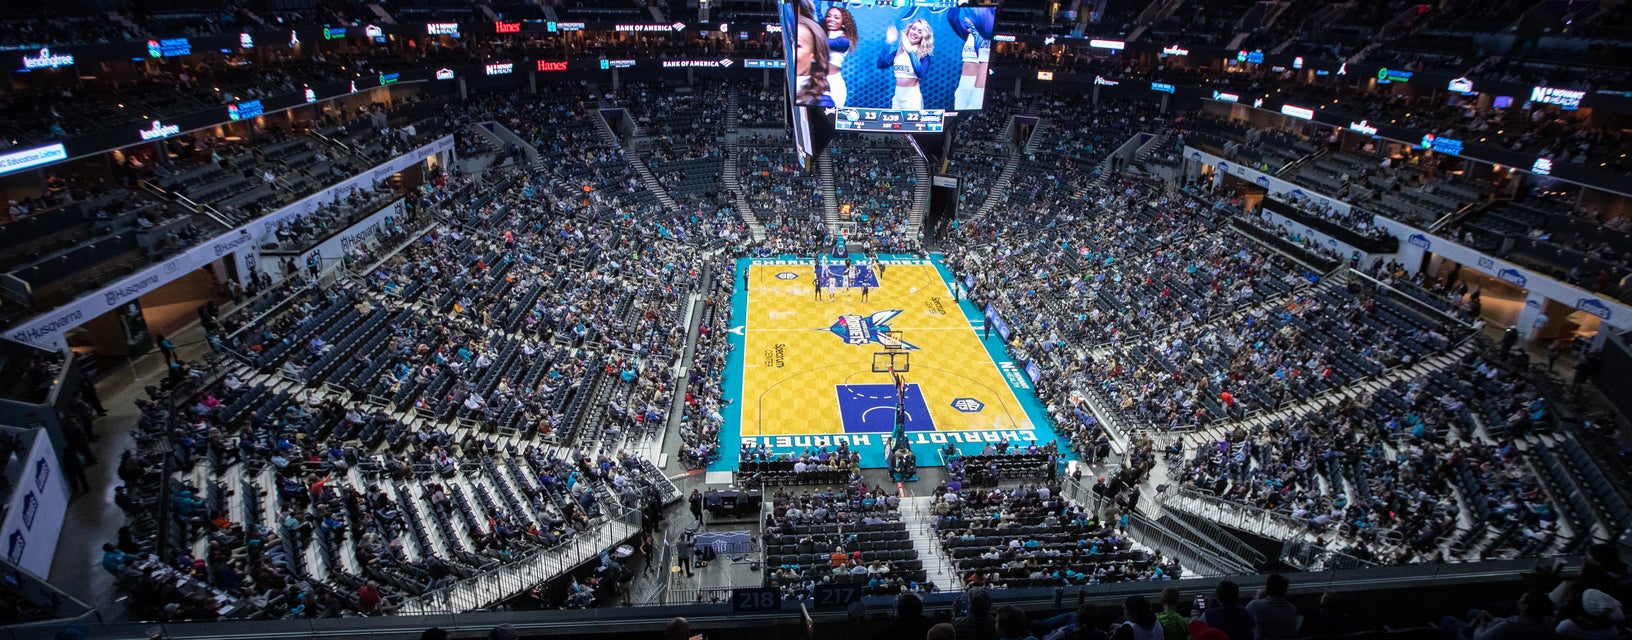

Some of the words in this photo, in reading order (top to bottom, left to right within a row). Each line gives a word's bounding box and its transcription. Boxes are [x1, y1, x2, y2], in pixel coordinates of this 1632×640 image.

[495, 21, 522, 33] Hanes
[766, 24, 782, 33] Spec
[23, 49, 74, 69] lendingtree
[537, 59, 568, 71] Hanes
[865, 112, 877, 120] 13
[907, 113, 919, 121] 22
[348, 222, 380, 246] Husqvarna
[115, 274, 160, 301] Husqvarna
[27, 309, 82, 342] Husqvarna
[775, 343, 786, 368] Spectrum
[740, 434, 871, 448] HORNETS
[738, 591, 775, 609] 218
[821, 588, 855, 605] 217
